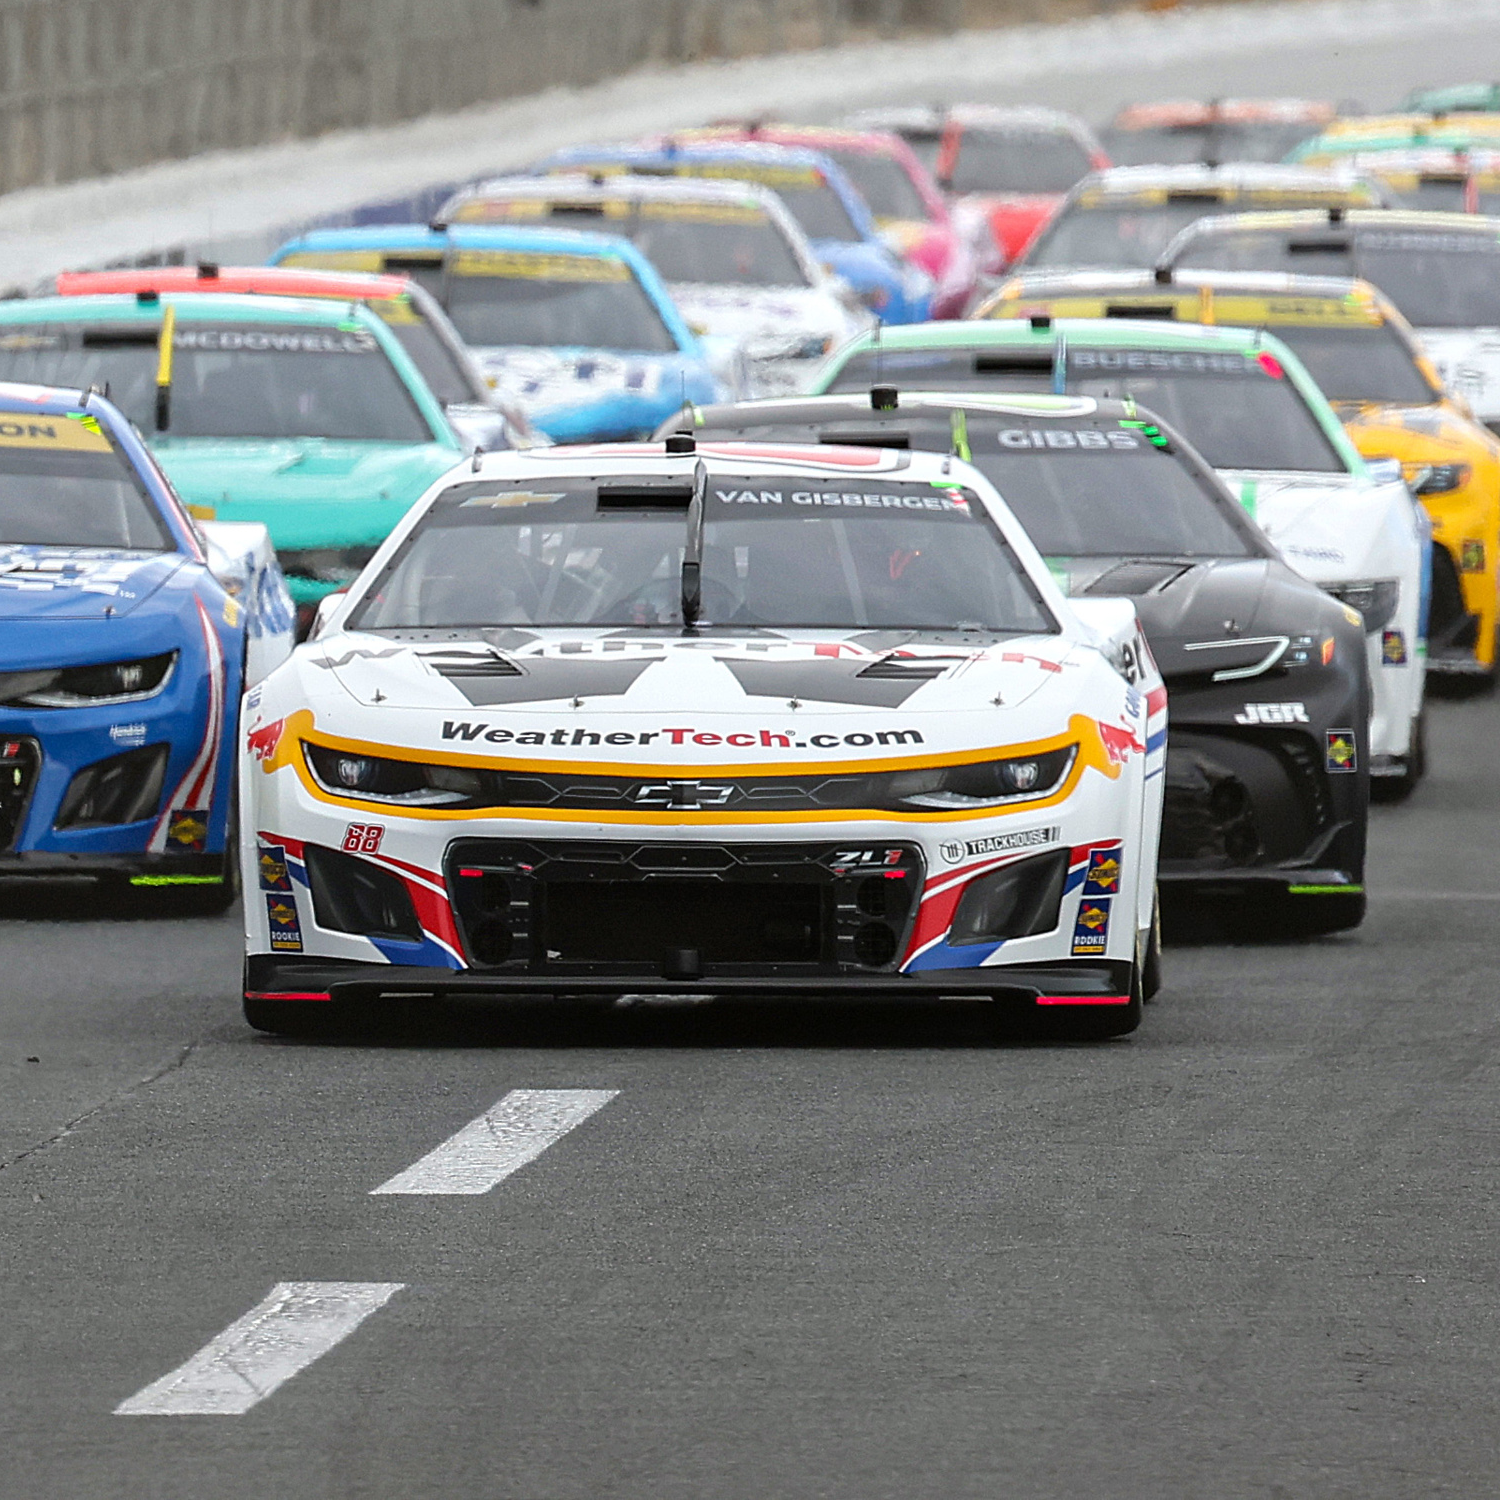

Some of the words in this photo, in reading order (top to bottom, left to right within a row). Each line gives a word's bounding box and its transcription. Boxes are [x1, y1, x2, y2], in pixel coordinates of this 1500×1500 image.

[998, 429, 1140, 449] GIBBS
[715, 490, 783, 503] VAN
[1234, 702, 1310, 724] JGR
[342, 822, 385, 854] 88
[970, 831, 1049, 854] TRACKHOUSE
[829, 850, 902, 867] ZL1
[271, 931, 300, 941] ROOKIE
